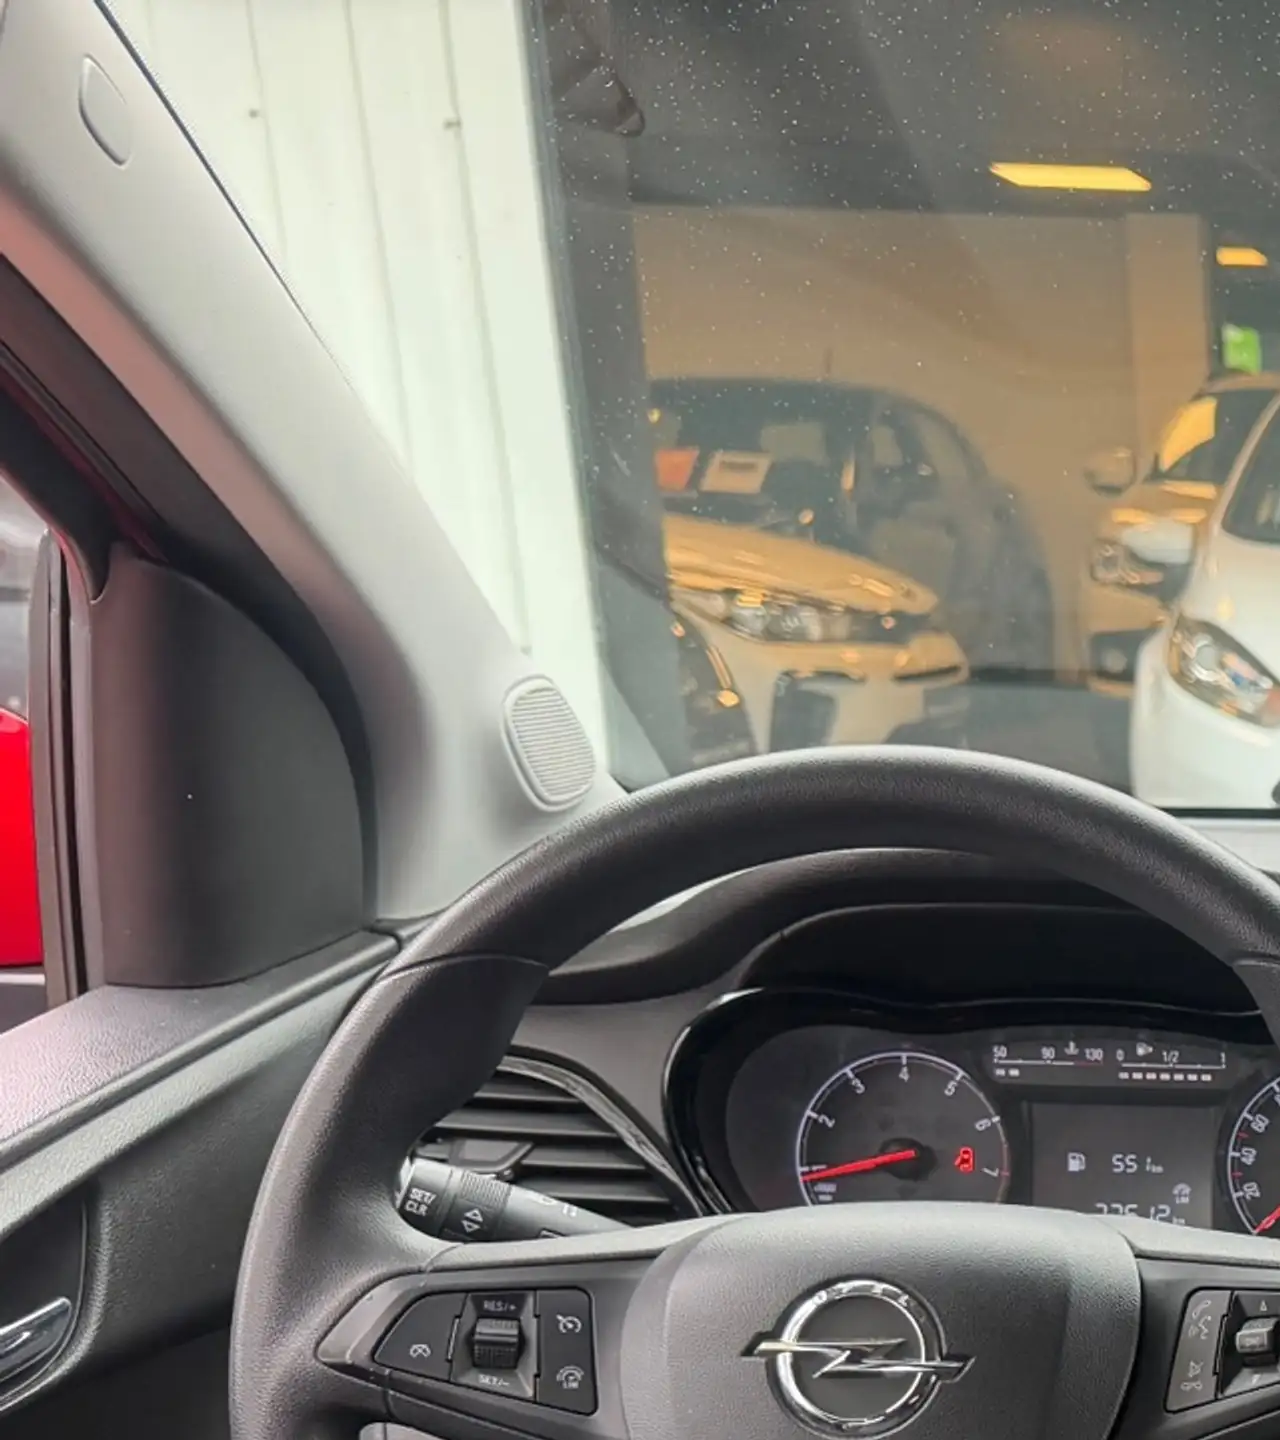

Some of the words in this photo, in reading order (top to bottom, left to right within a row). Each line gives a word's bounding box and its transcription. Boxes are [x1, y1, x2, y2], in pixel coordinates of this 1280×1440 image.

[993, 1046, 1007, 1058] 50
[1042, 1047, 1055, 1060] 90
[1085, 1048, 1103, 1061] 130
[1162, 1051, 1179, 1063] 1/2
[899, 1066, 910, 1082] 4
[851, 1078, 866, 1095] 3
[944, 1080, 958, 1097] 5
[818, 1113, 836, 1129] 2
[974, 1117, 991, 1132] 6
[982, 1166, 1000, 1178] 7
[1243, 1181, 1261, 1199] 20
[405, 1201, 429, 1217] CLR
